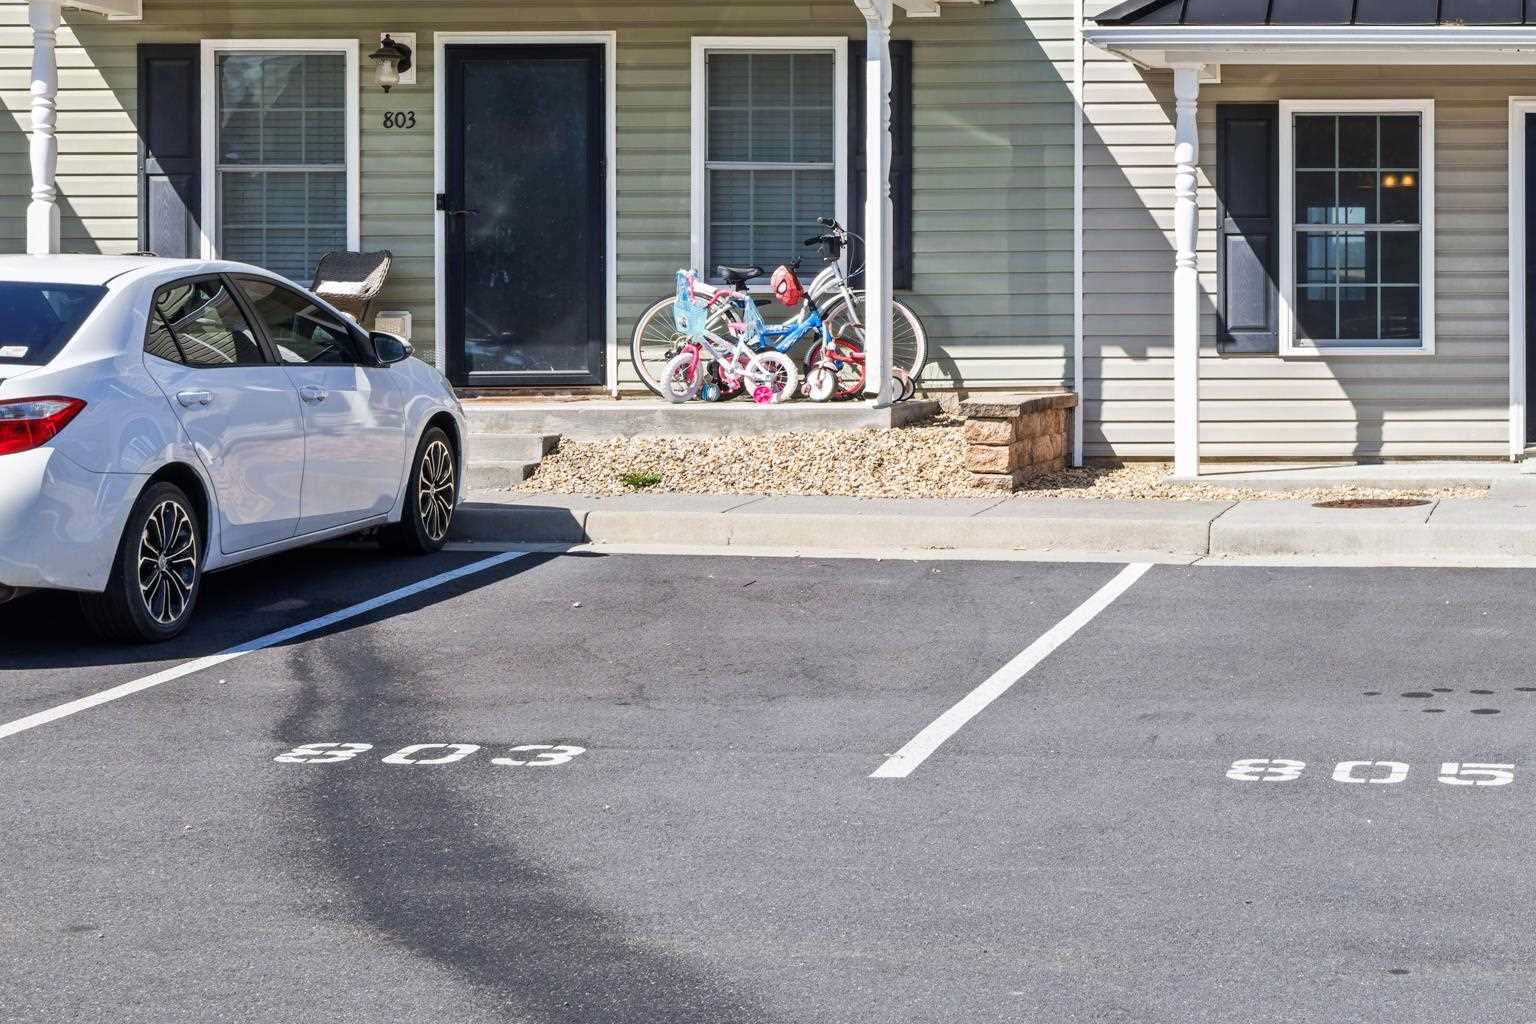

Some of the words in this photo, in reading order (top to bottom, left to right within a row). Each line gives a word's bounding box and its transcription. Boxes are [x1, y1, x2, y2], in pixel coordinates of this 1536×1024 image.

[382, 110, 417, 129] 803
[273, 742, 586, 766] 803
[1225, 758, 1516, 786] 805
